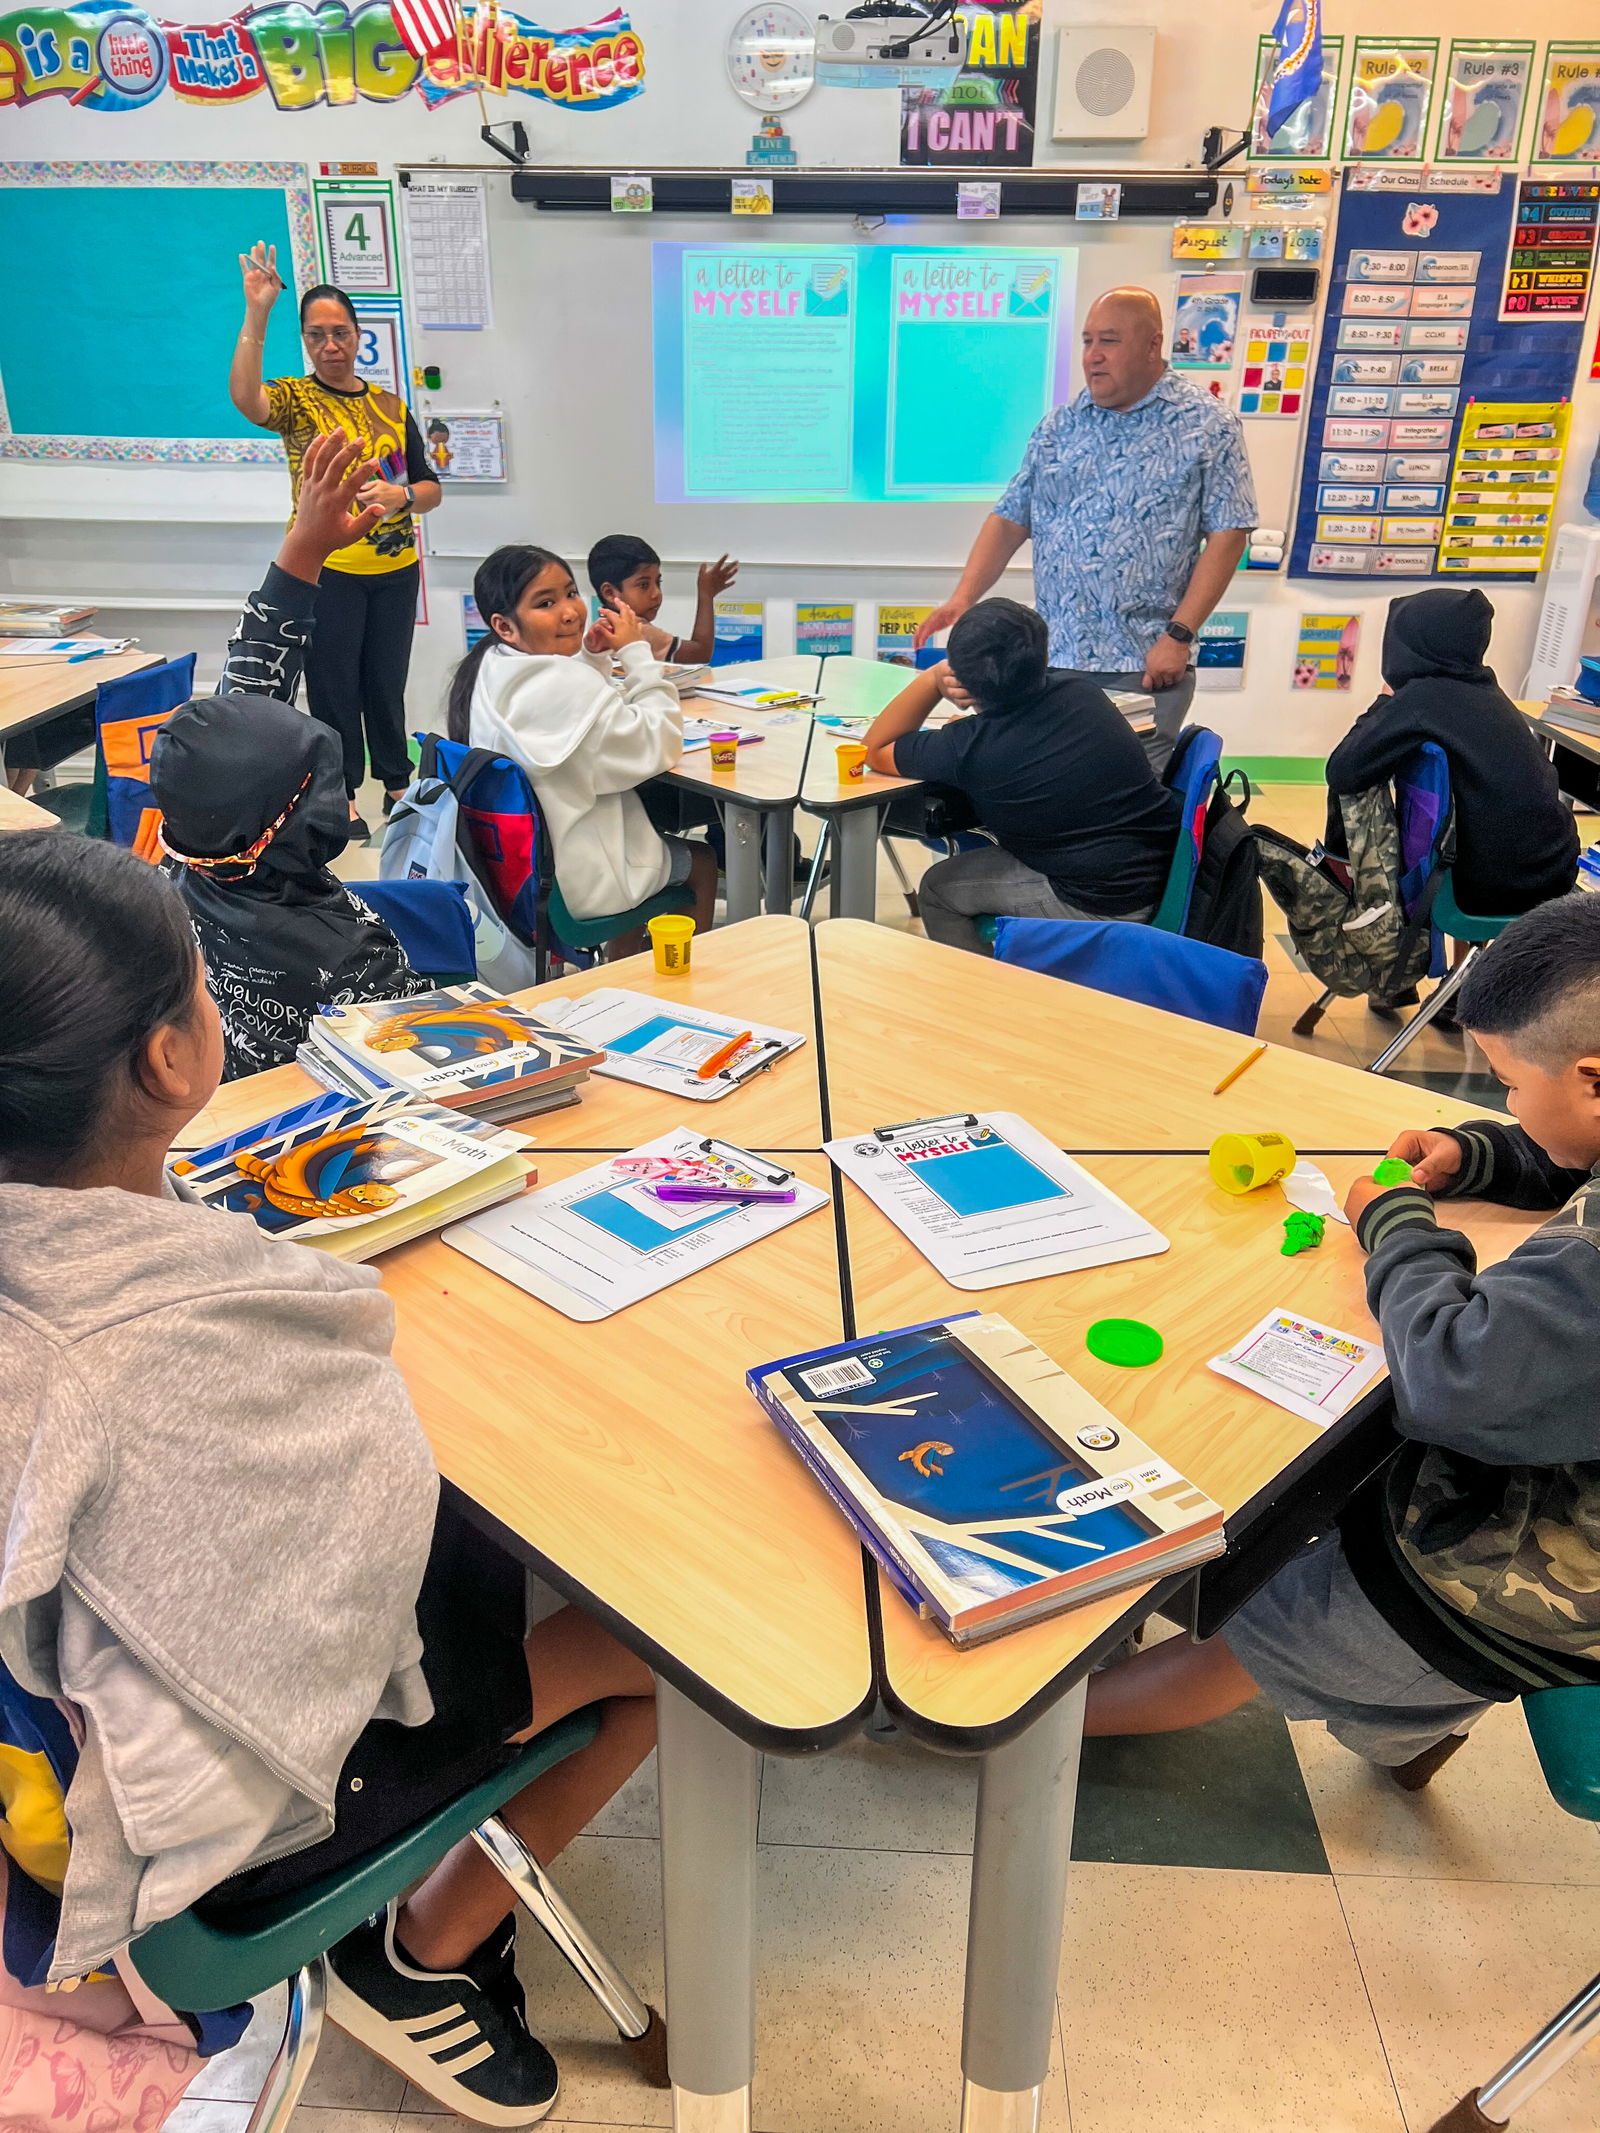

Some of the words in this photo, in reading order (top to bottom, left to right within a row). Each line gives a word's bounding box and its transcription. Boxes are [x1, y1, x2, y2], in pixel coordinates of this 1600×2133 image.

[107, 34, 148, 56] little
[184, 29, 239, 60] That
[944, 14, 1027, 67] AN
[18, 25, 60, 78] is
[70, 39, 89, 72] a
[110, 56, 152, 77] thing
[176, 56, 240, 86] Makes
[243, 53, 256, 76] a
[1366, 61, 1397, 75] Rule
[1463, 61, 1495, 76] Rule
[1501, 62, 1520, 76] #3
[1557, 65, 1589, 79] Rule
[907, 112, 920, 151] I
[926, 111, 1023, 151] CAN'T
[759, 139, 783, 149] LIVE
[1380, 175, 1397, 184] Our
[1398, 176, 1421, 186] Class
[1429, 177, 1470, 187] Schedule
[344, 212, 371, 251] 4
[1258, 234, 1280, 246] 20
[1288, 236, 1320, 248] 2025
[1179, 234, 1229, 251] August
[339, 252, 383, 262] Advanced
[696, 267, 709, 287] a
[717, 258, 772, 290] letter
[774, 260, 801, 289] to
[903, 269, 918, 288] a
[922, 261, 976, 290] letter
[979, 263, 1004, 289] to
[693, 290, 801, 317] MYSELF
[899, 292, 1005, 318] MYSELF
[356, 329, 379, 367] 3
[354, 367, 390, 377] roficient
[879, 622, 900, 635] HELP
[903, 622, 918, 635] US
[1203, 625, 1235, 637] DEEP!
[423, 1065, 475, 1083] Math
[441, 1138, 488, 1161] Math
[893, 1145, 905, 1154] a
[907, 1137, 941, 1152] letter
[943, 1134, 961, 1144] to
[896, 1140, 970, 1163] MYSELF
[1140, 1468, 1158, 1479] HMH
[1066, 1486, 1114, 1508] Math
